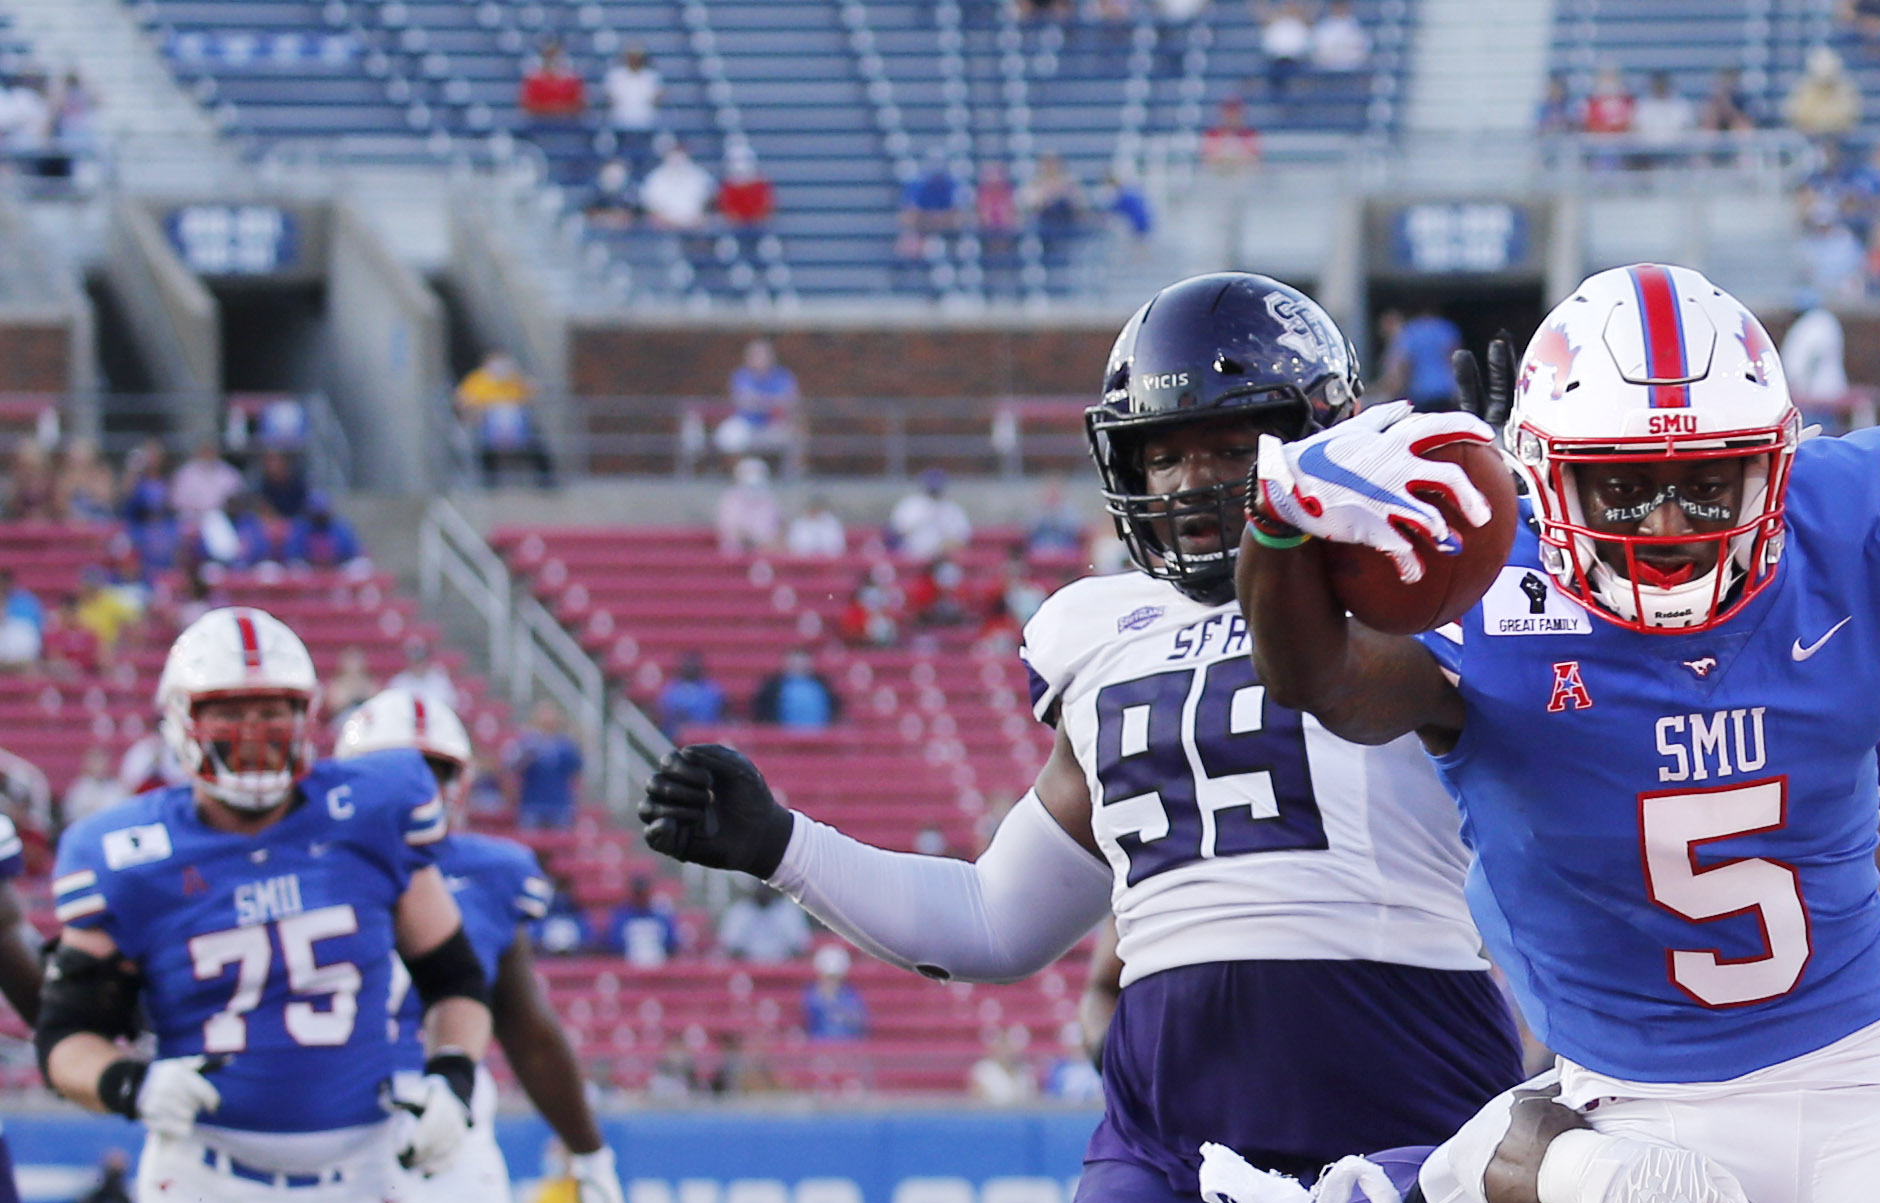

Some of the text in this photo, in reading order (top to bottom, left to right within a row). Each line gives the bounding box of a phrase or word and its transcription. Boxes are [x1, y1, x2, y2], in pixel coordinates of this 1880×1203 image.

[1142, 372, 1189, 391] VICIS
[1649, 414, 1698, 435] SMU
[1166, 613, 1249, 661] SFA
[1499, 618, 1579, 632] GREAT FAMILY
[1654, 608, 1694, 620] Riddell
[1547, 661, 1593, 713] A
[1655, 706, 1767, 783] SMU
[1096, 654, 1330, 888] 99
[327, 784, 355, 820] C
[234, 873, 303, 928] SMU
[1637, 774, 1814, 1009] 5
[187, 902, 363, 1055] 75
